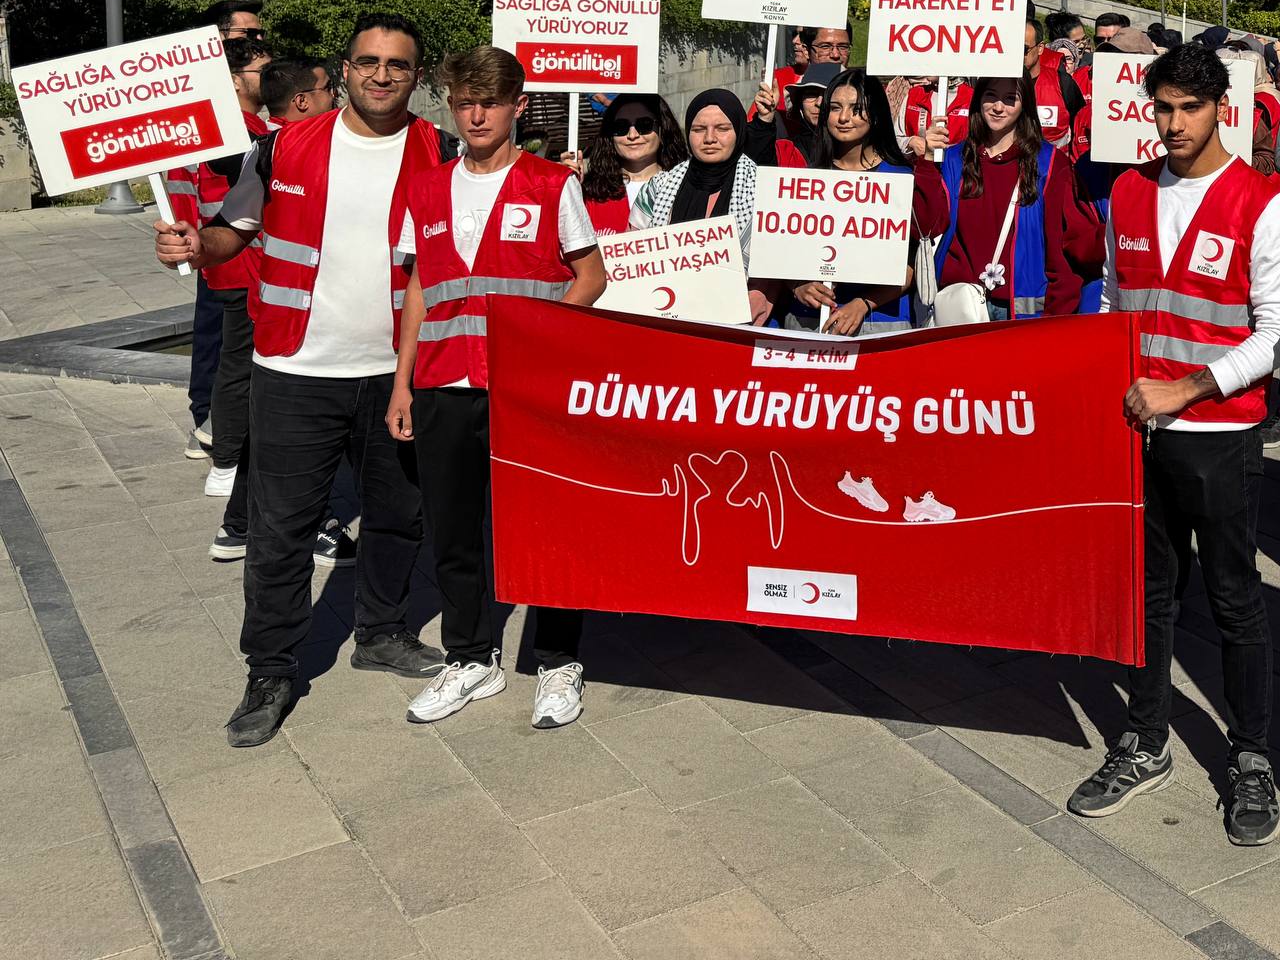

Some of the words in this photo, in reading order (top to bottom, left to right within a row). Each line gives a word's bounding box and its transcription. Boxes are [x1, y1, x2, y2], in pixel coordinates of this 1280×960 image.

[762, 5, 788, 13] KIZILAY
[527, 18, 628, 36] YÜRÜYORUZ
[888, 24, 1003, 54] KONYA
[19, 63, 115, 99] SAĞLIĞA
[120, 37, 223, 77] GÖNÜLLÜ
[64, 74, 193, 117] YÜRÜYORUZ
[778, 177, 826, 201] HER
[833, 176, 890, 204] GÜN
[757, 211, 835, 236] 10.000
[842, 216, 907, 240] ADIM
[603, 232, 669, 260] REKETLİ
[673, 224, 734, 248] YAŞAM
[1119, 234, 1150, 252] Gönüllü
[671, 249, 730, 272] YAŞAM
[1197, 265, 1219, 275] KIZILAY
[763, 347, 796, 362] 3-4
[806, 345, 849, 364] EKİM
[567, 373, 697, 423] DÜNYA
[713, 381, 901, 442] YÜRÜYÜŞ
[913, 389, 1035, 435] GÜNÜ
[764, 590, 788, 598] OLMAZ
[765, 583, 788, 592] SENSİZ
